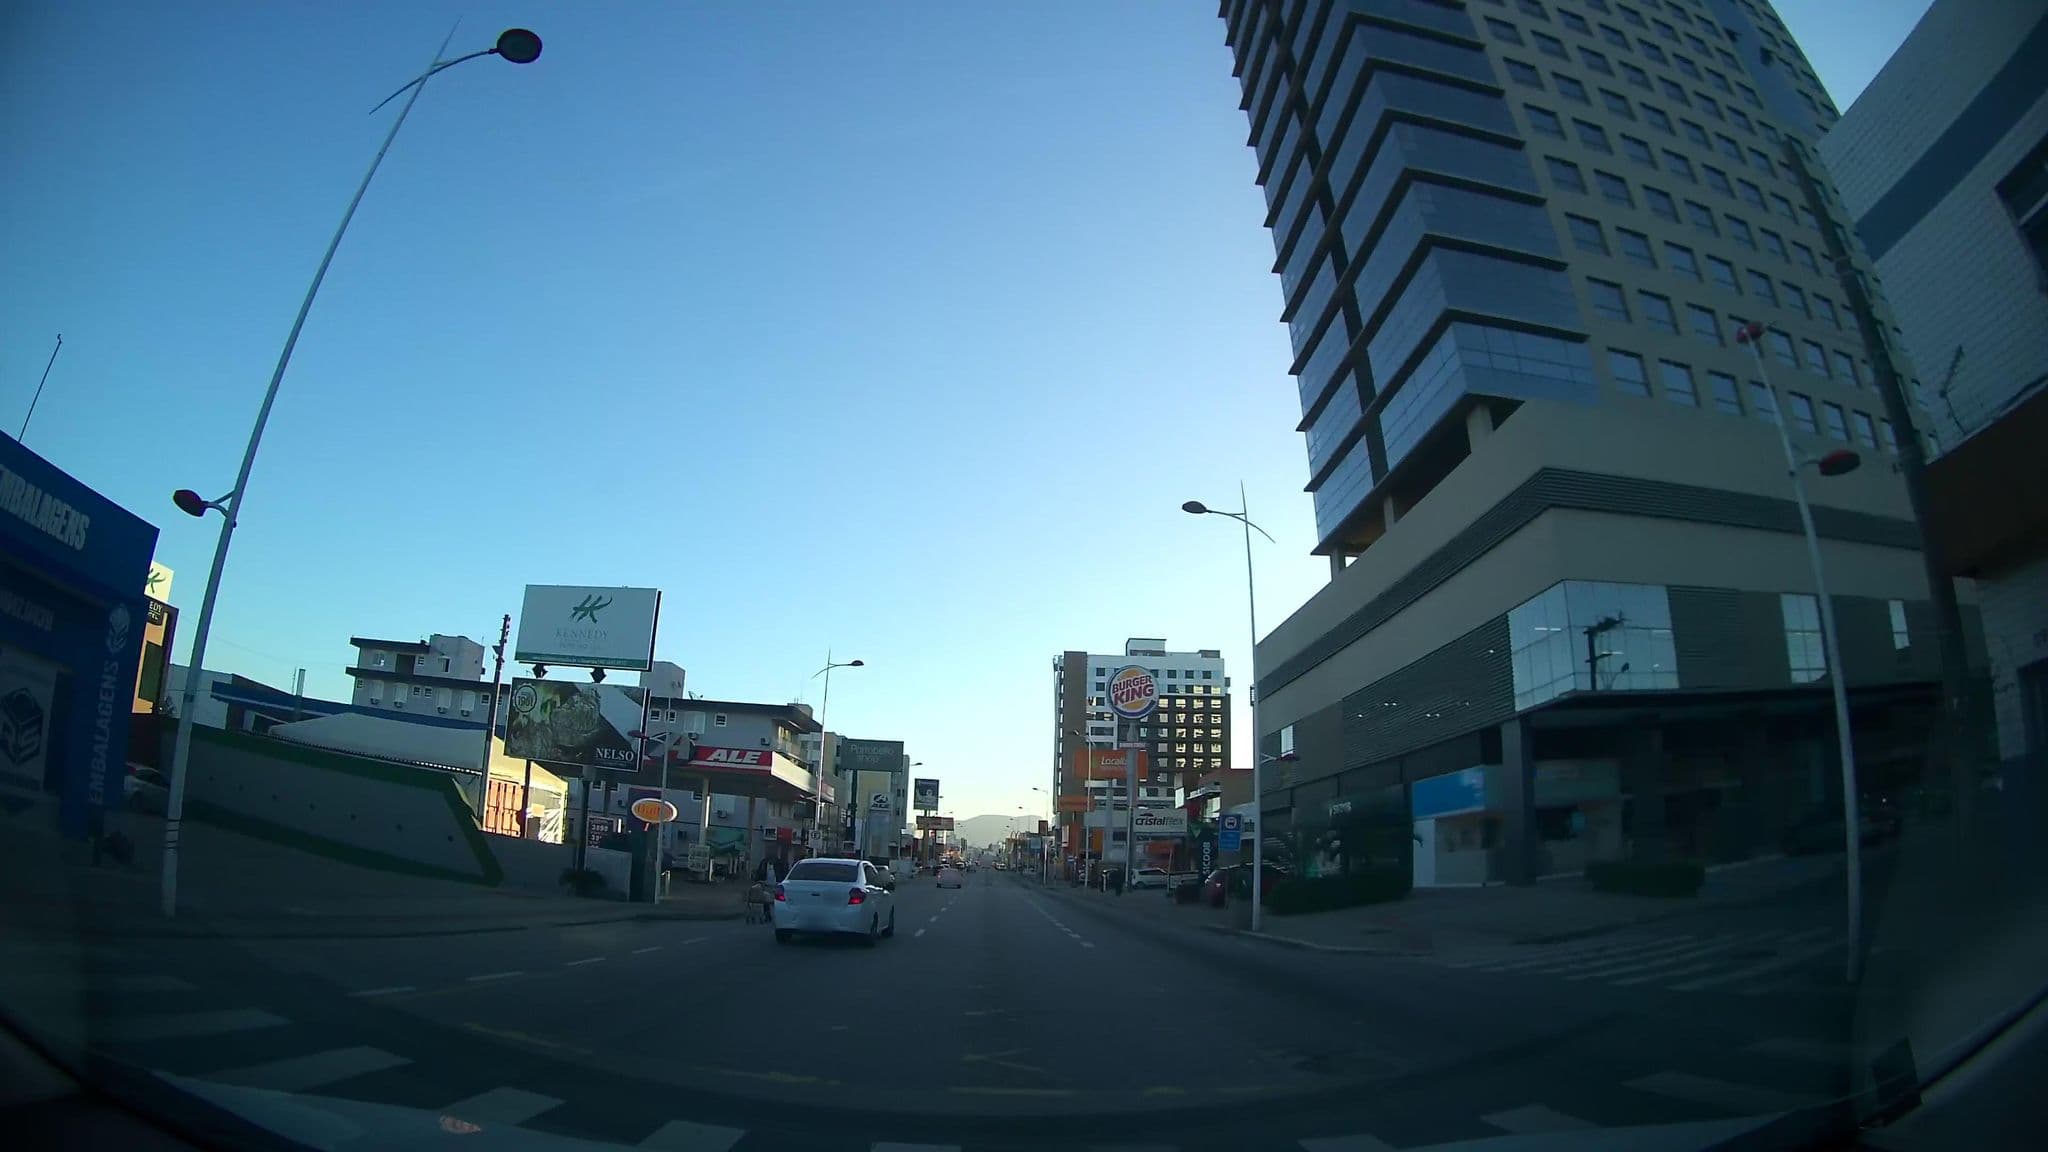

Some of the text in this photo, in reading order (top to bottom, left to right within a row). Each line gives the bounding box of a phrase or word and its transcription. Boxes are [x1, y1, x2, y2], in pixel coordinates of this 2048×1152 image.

[0, 464, 90, 551] MBALAGENS
[553, 626, 609, 642] KENNEDY
[1112, 675, 1153, 694] BURGER
[1113, 683, 1154, 706] KING
[87, 660, 119, 805] EMBALAGENS
[595, 747, 634, 761] NELSO
[708, 749, 763, 764] ALE
[1101, 755, 1128, 765] Locali
[1202, 841, 1211, 875] SICOOB
